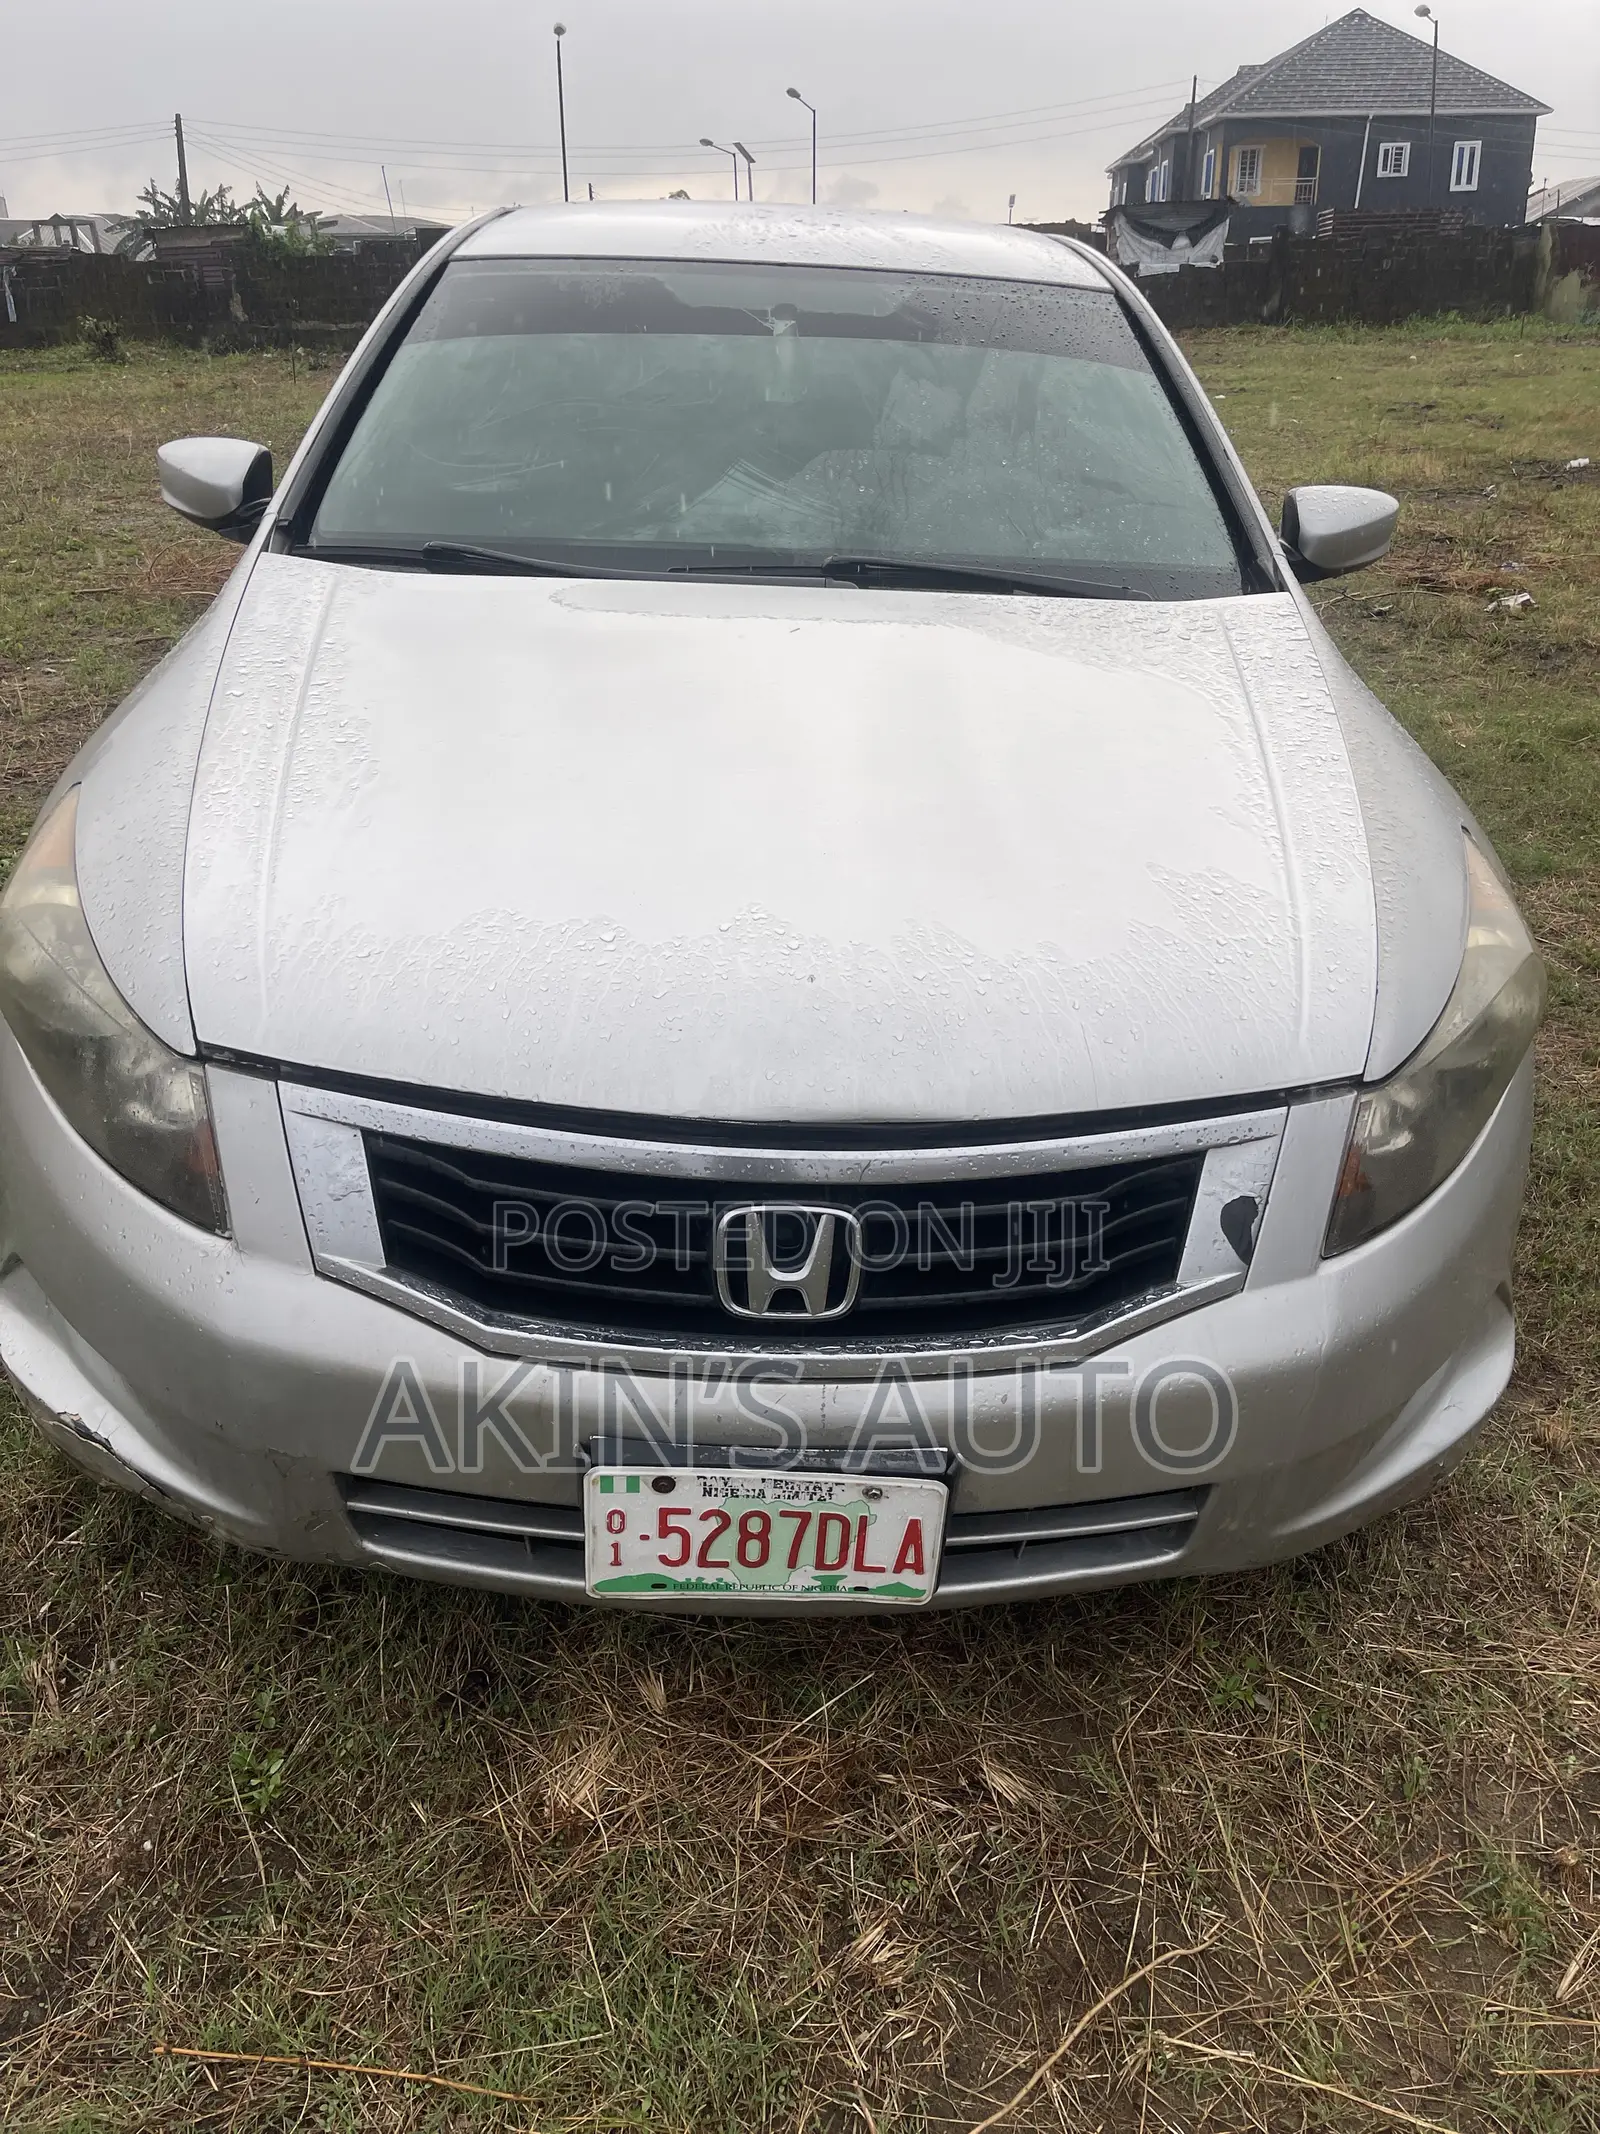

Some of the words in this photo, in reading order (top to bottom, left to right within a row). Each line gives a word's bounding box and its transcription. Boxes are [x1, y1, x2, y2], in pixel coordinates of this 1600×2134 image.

[672, 1583, 724, 1591] FEDERAL
[725, 1583, 780, 1591] REPUBLIC
[801, 1584, 848, 1592] NIGERIA
